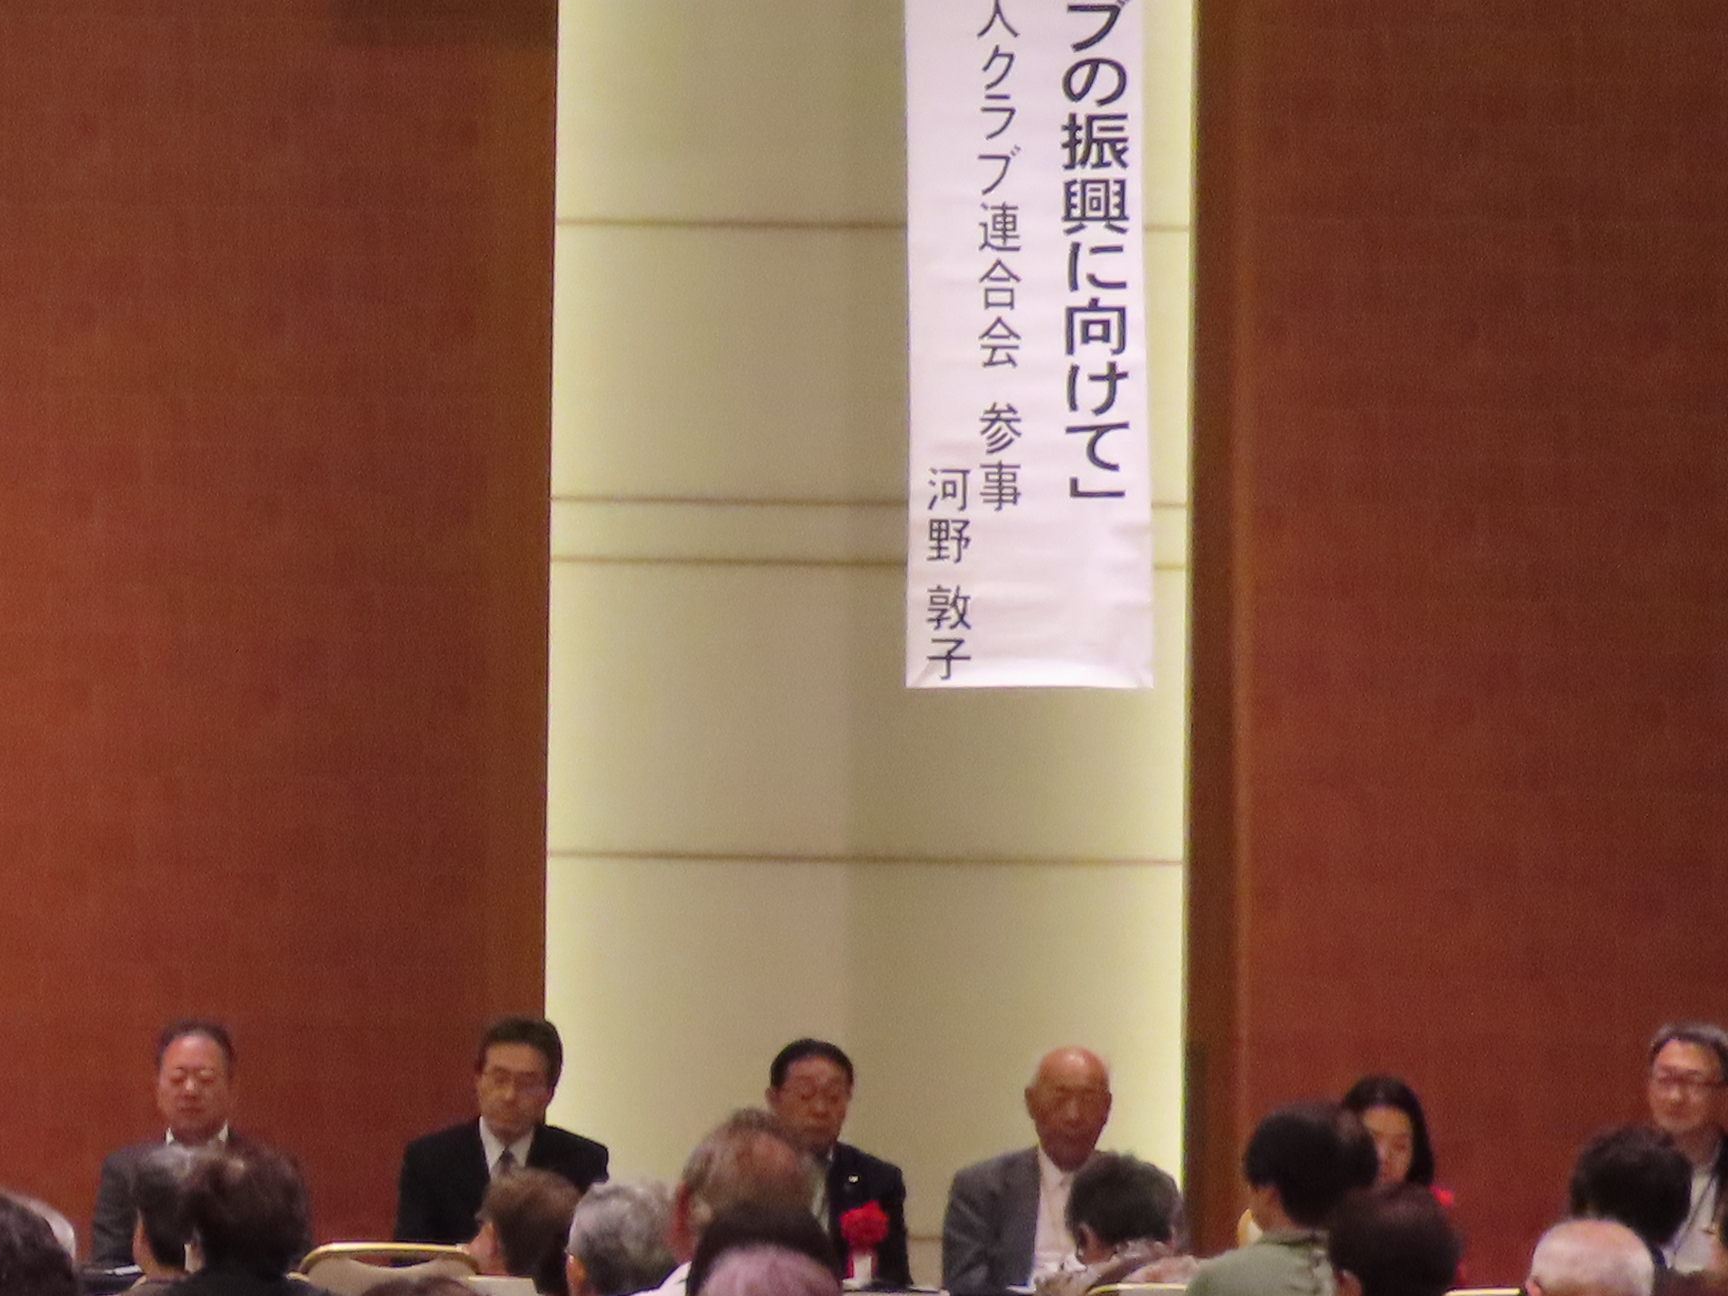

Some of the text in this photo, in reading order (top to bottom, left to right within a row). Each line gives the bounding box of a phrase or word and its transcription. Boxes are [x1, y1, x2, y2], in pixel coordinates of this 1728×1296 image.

[978, 401, 1023, 513] 参事
[925, 466, 973, 681] 河野 敦子
